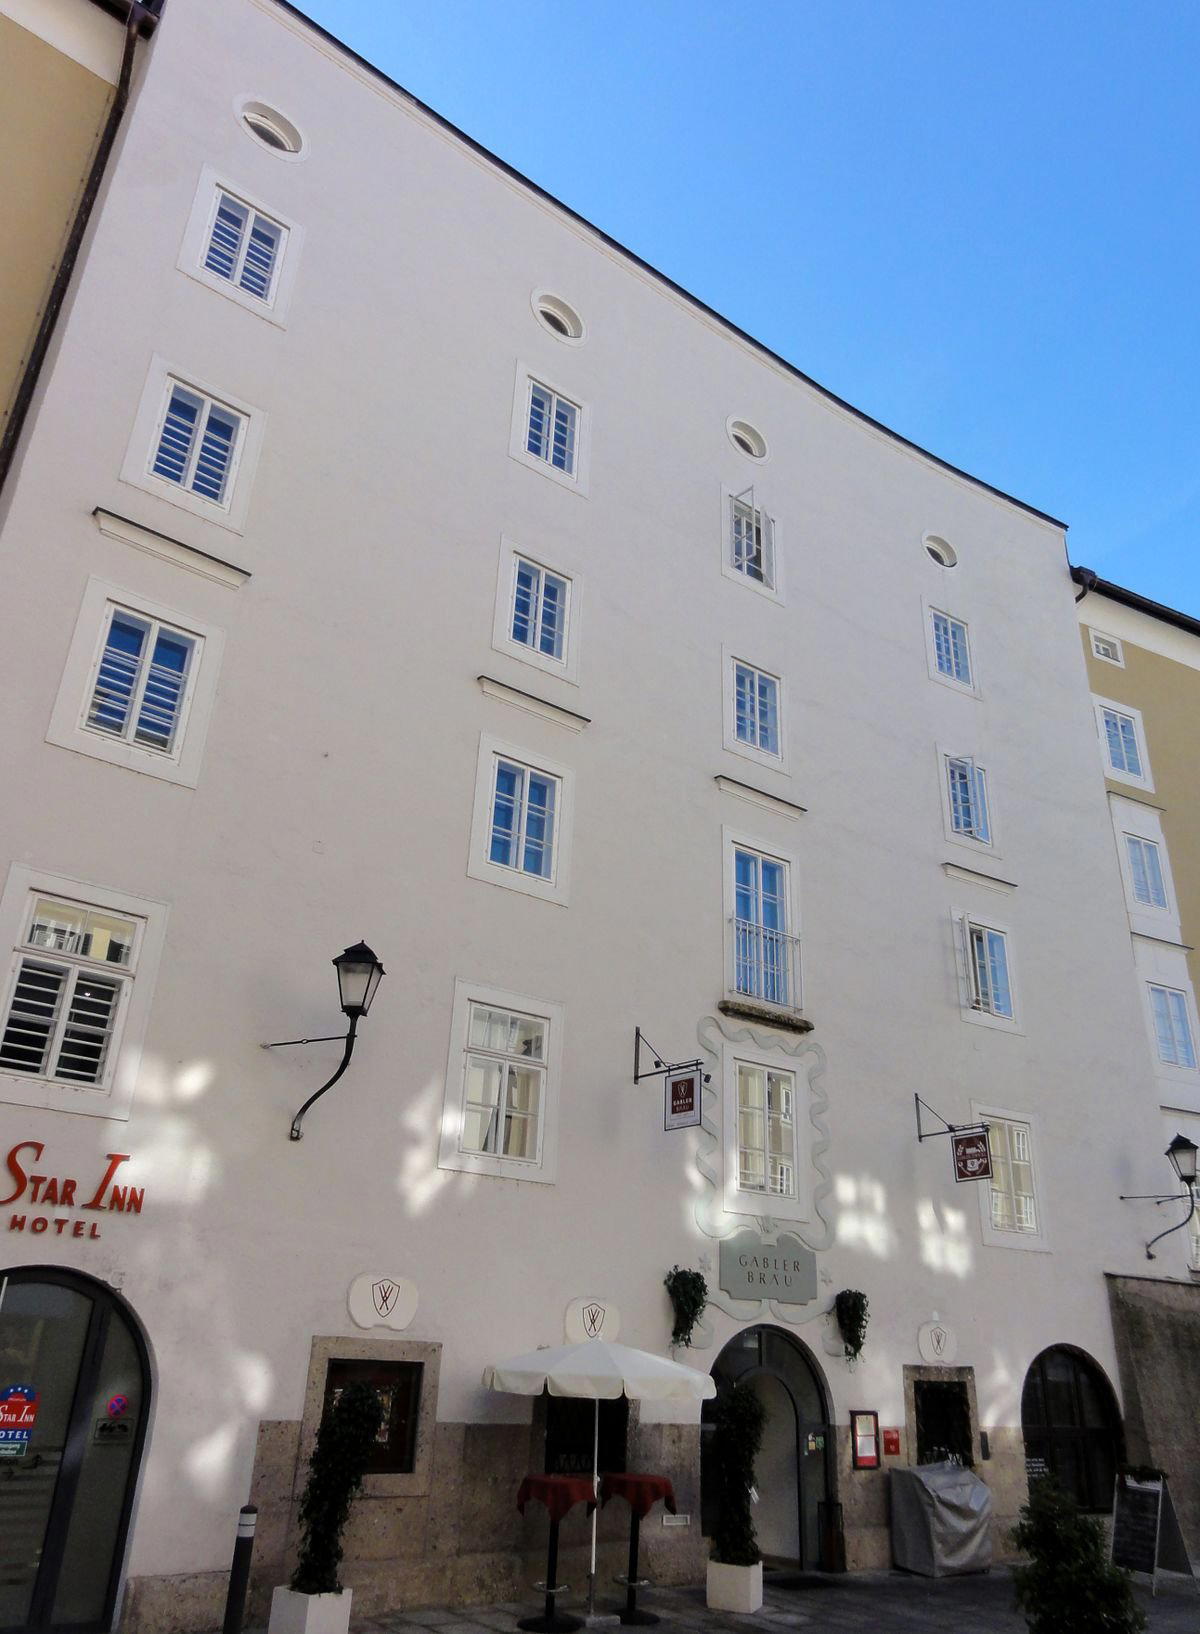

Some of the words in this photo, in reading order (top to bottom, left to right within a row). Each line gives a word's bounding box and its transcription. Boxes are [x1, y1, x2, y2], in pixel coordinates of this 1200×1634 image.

[0, 1140, 77, 1207] STAR
[81, 1153, 146, 1214] INN
[9, 1214, 102, 1240] HOTEL
[738, 1254, 801, 1272] GABLER
[0, 1430, 28, 1439] OTEL
